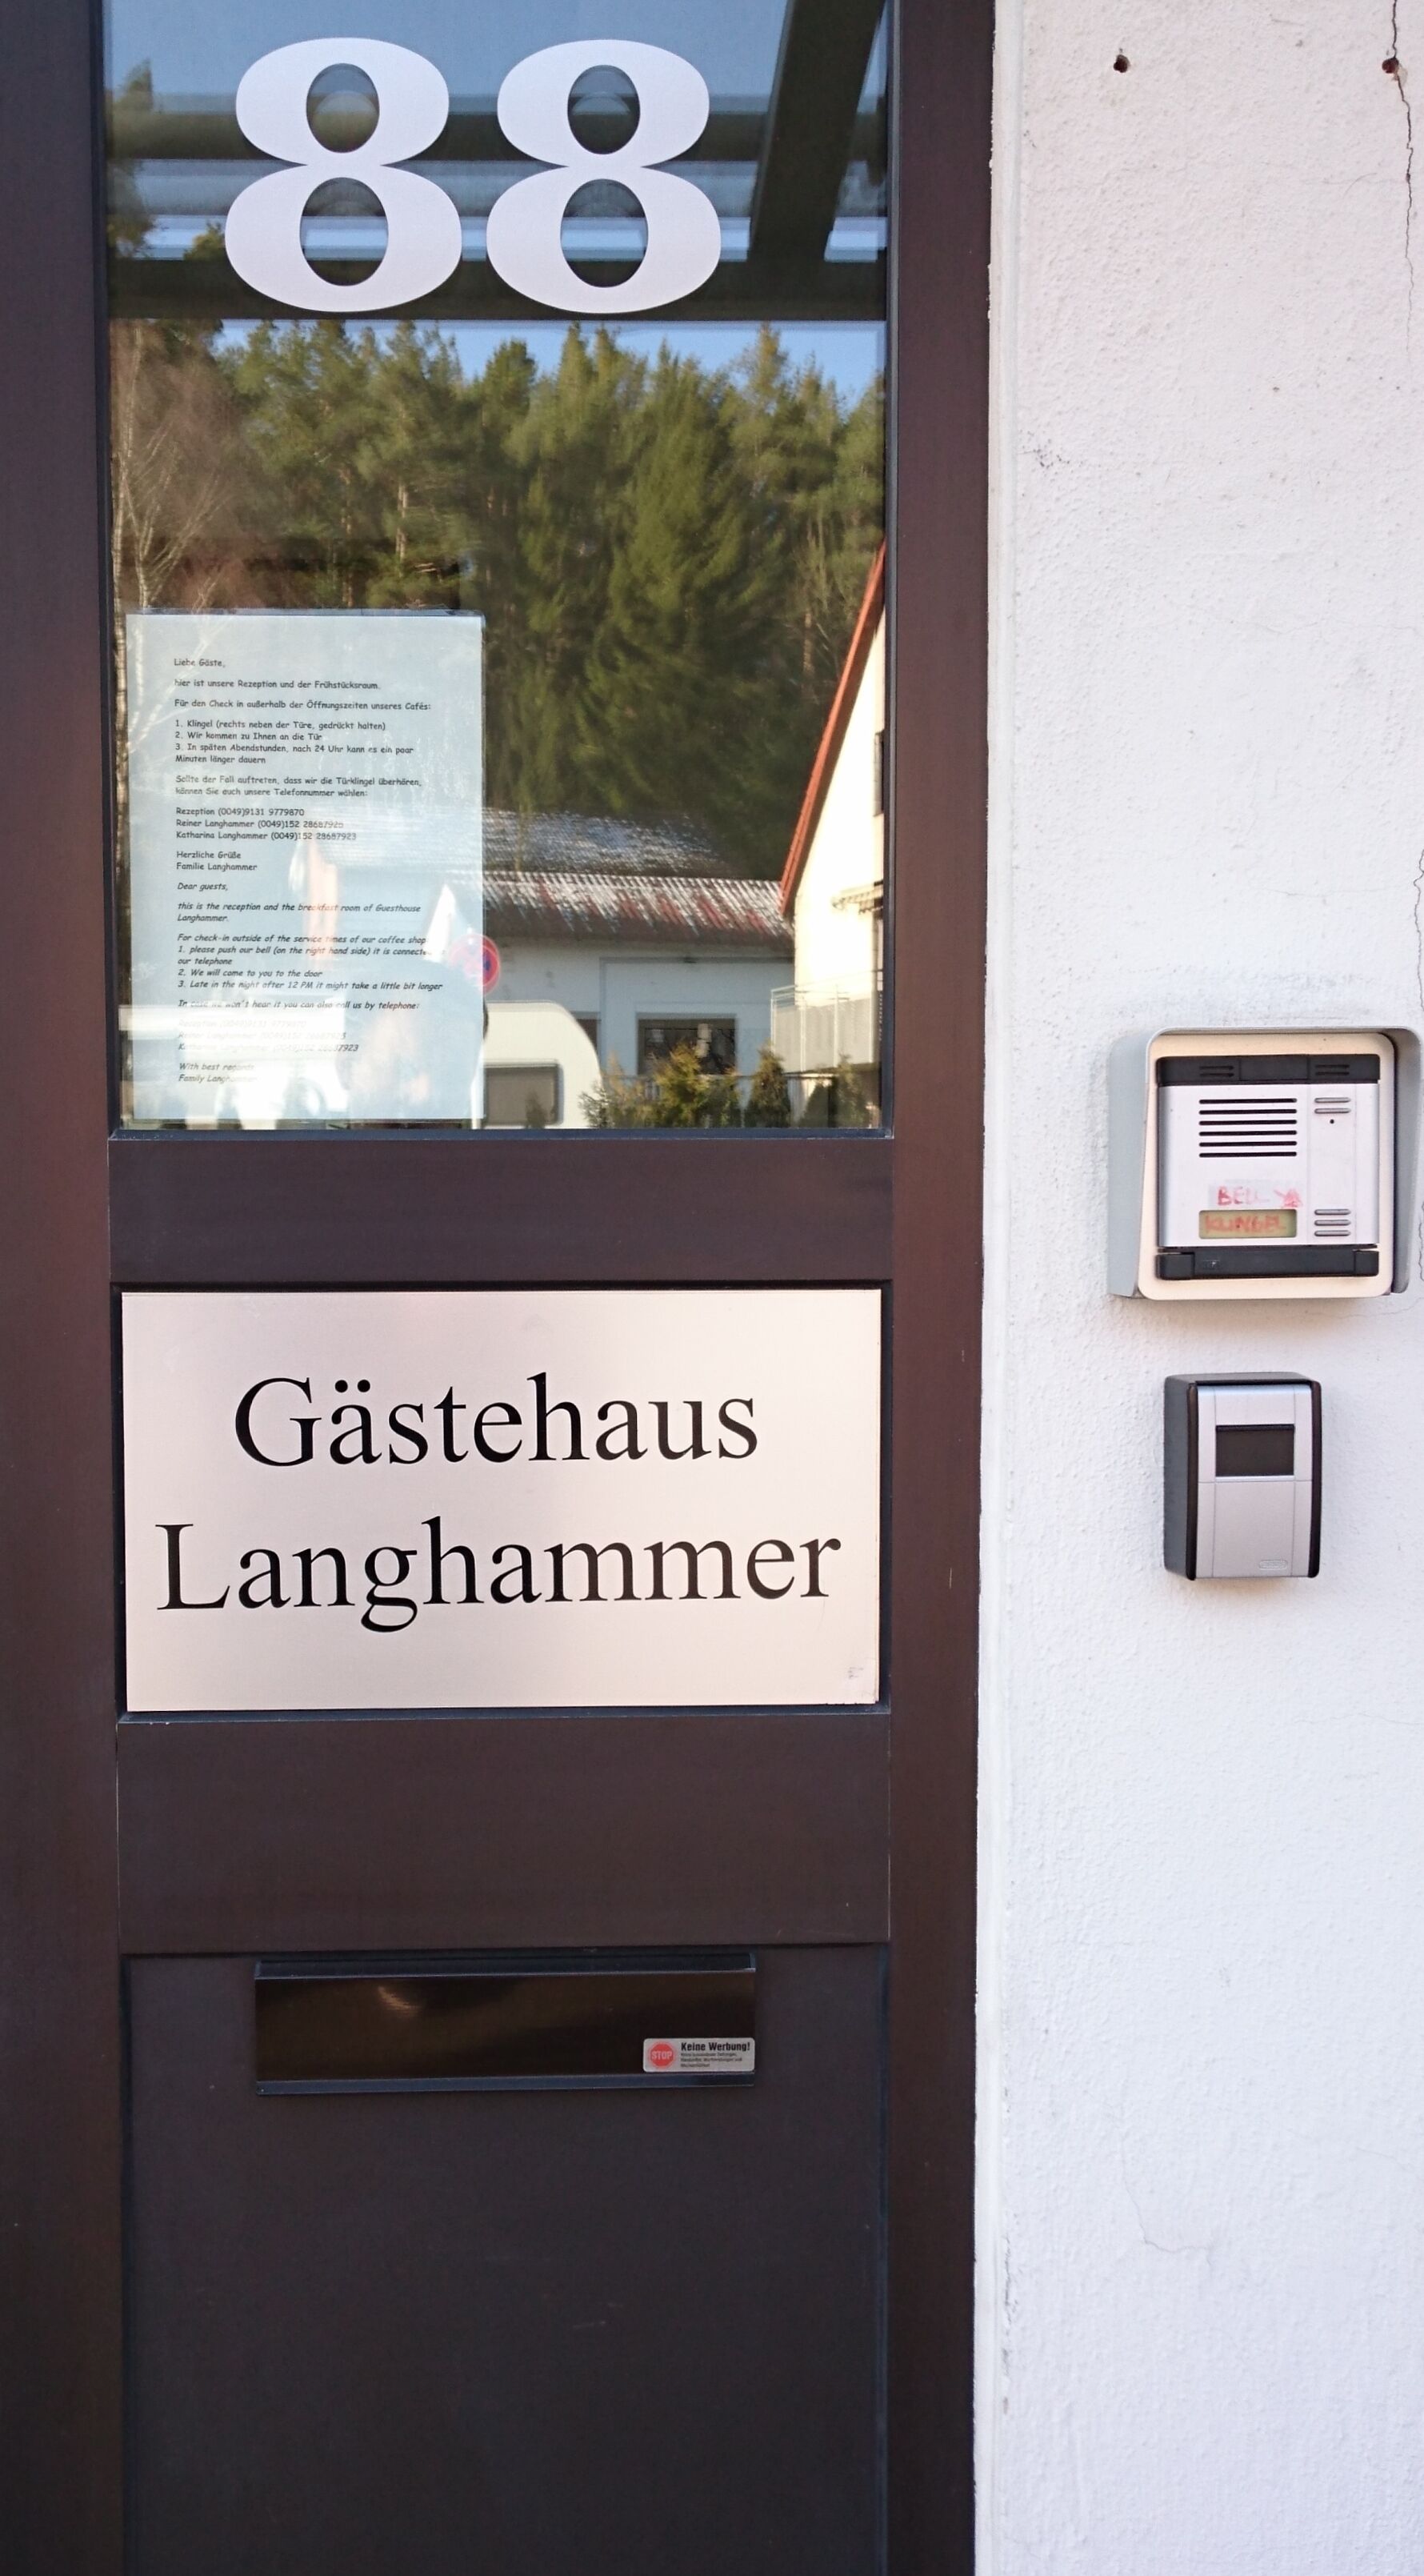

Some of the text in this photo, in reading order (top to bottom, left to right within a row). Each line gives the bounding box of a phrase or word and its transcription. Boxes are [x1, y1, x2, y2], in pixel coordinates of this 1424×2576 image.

[225, 37, 722, 313] 88
[198, 659, 226, 668] Gäste,
[194, 679, 205, 687] ist
[237, 679, 278, 689] Rezeption
[314, 680, 381, 688] Frühstücksraum.
[174, 699, 189, 707] Für
[236, 699, 244, 707] in
[306, 699, 368, 711] Öffnungszeiten
[405, 701, 431, 709] Cafés:
[186, 719, 213, 729] Klingel
[216, 719, 246, 730] (rechts
[275, 720, 290, 728] der
[293, 720, 314, 731] Türe,
[318, 721, 354, 731] gedrückt
[357, 721, 386, 731] halten)
[174, 731, 182, 739] 2.
[308, 732, 322, 740] Tür
[200, 743, 227, 753] späten
[230, 743, 288, 753] Abendstunden,
[314, 744, 325, 752] 24
[328, 744, 344, 752] Uhr
[380, 745, 393, 753] ein
[395, 747, 414, 755] paar
[175, 755, 266, 765] Minuten länger dauern
[175, 775, 199, 783] Sollte
[238, 775, 279, 786] auftreten,
[283, 776, 302, 784] dass
[305, 776, 318, 784] wir
[336, 777, 375, 787] Türklingel
[378, 778, 422, 787] überhören,
[206, 787, 219, 795] Sie
[338, 788, 368, 796] wählen:
[175, 807, 305, 817] Rezeption (0049)9131 9779870
[176, 819, 202, 827] Reiner
[205, 819, 254, 829] Langhammer
[176, 831, 215, 839] Katharina
[218, 831, 268, 841] Langhammer
[176, 862, 258, 872] Familie Langhammer
[200, 882, 229, 892] guests,
[178, 902, 194, 910] this
[196, 902, 203, 910] is
[206, 902, 220, 910] the
[222, 903, 262, 912] reception
[282, 903, 296, 911] the
[363, 903, 374, 911] of
[375, 903, 422, 911] Guesthouse
[178, 914, 229, 923] Langhammer.
[178, 933, 192, 941] For
[232, 934, 262, 942] outside
[264, 934, 274, 942] of
[277, 934, 291, 942] the
[350, 935, 360, 943] of
[378, 935, 406, 943] coffee
[178, 945, 185, 953] 1.
[190, 946, 215, 955] please
[218, 946, 237, 955] push
[255, 946, 271, 954] bell
[274, 947, 286, 956] (on
[350, 947, 371, 957] side)
[194, 956, 233, 967] telephone
[178, 968, 186, 976] 2.
[190, 968, 204, 976] We
[206, 968, 221, 976] will
[258, 971, 274, 979] you
[304, 969, 323, 977] door
[190, 980, 209, 988] Late
[211, 980, 219, 988] in
[222, 980, 235, 988] the
[238, 980, 259, 990] night
[288, 980, 298, 988] 12
[301, 980, 314, 988] PM
[316, 980, 324, 988] it
[326, 980, 349, 991] might
[381, 981, 401, 989] little
[403, 981, 416, 989] bit
[418, 981, 444, 992] longer
[252, 1000, 272, 1008] hear
[365, 1000, 376, 1010] by
[378, 1001, 420, 1011] telephone:
[235, 1372, 758, 1466] Gästehaus
[154, 1516, 842, 1633] Langhammer
[681, 2042, 750, 2052] Keine Werbung!
[651, 2050, 673, 2060] STOP
